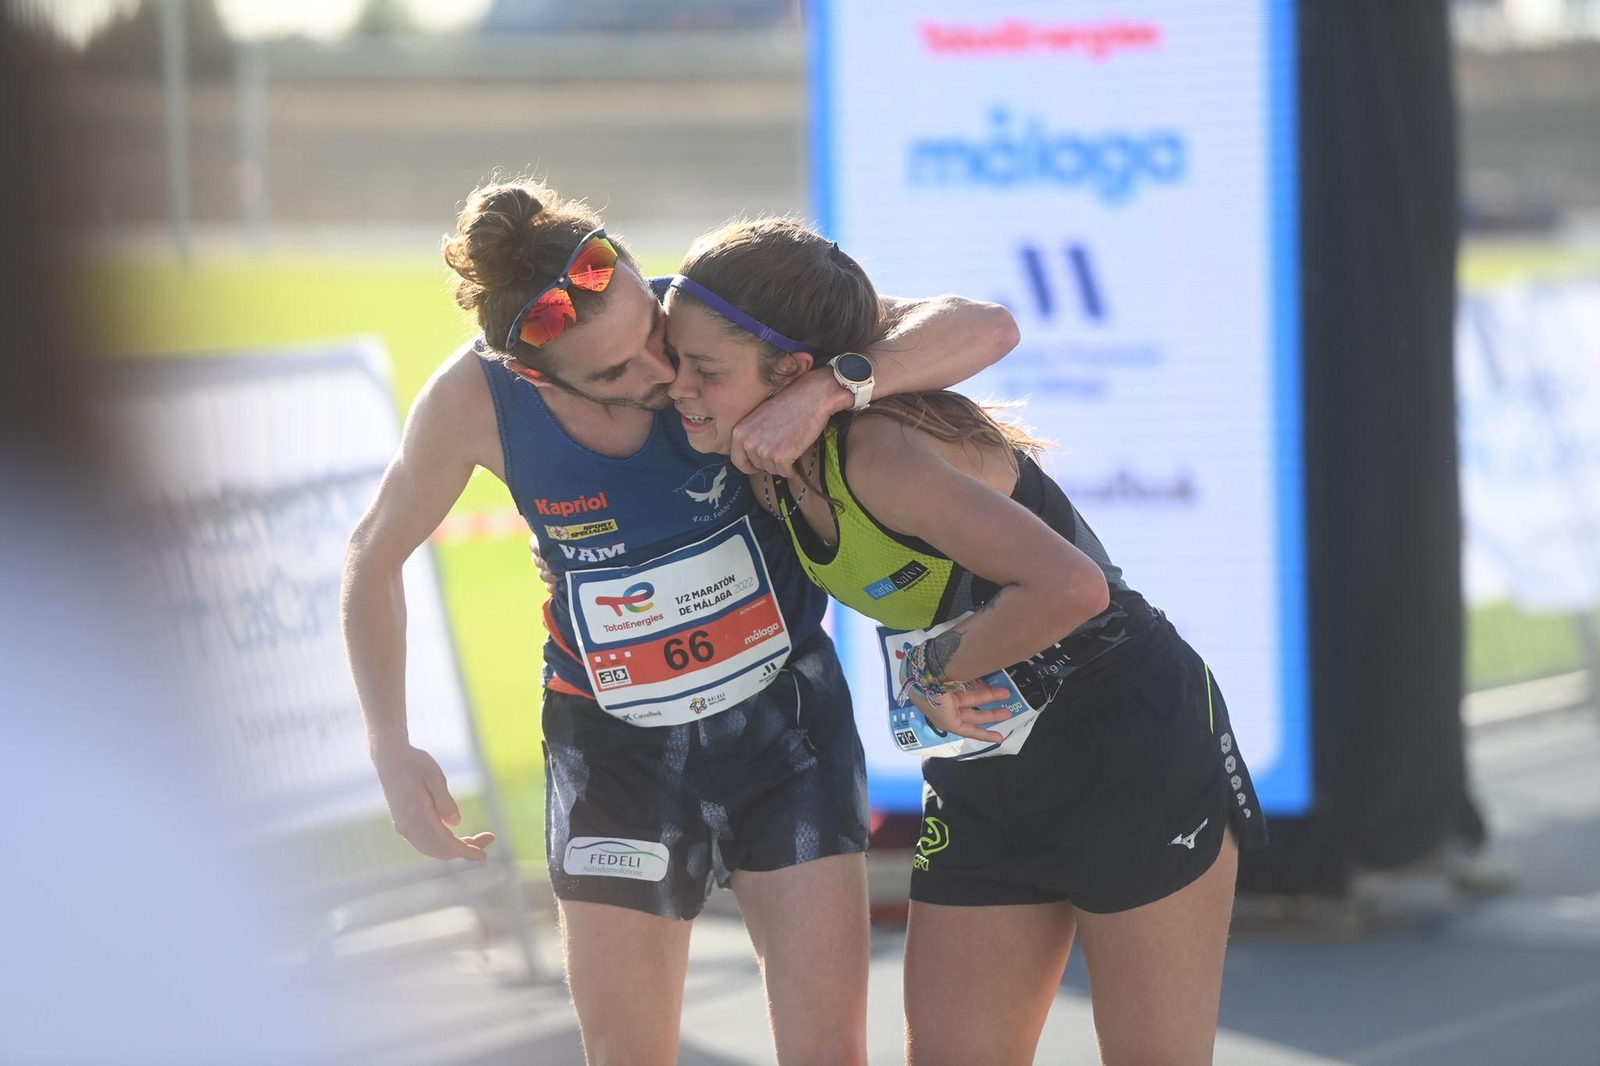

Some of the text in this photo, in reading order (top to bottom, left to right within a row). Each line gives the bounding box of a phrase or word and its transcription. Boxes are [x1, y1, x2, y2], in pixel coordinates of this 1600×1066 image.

[534, 491, 608, 518] Kapriol
[571, 526, 614, 538] SPECIALIST
[583, 521, 613, 531] SPORT
[558, 542, 626, 562] VAM
[675, 574, 736, 605] 1/2 MARATÓN
[679, 576, 755, 616] DE MÁLAGA 2022
[603, 613, 664, 632] TotalEnergies
[663, 630, 715, 671] 66
[589, 853, 641, 868] FEDELI
